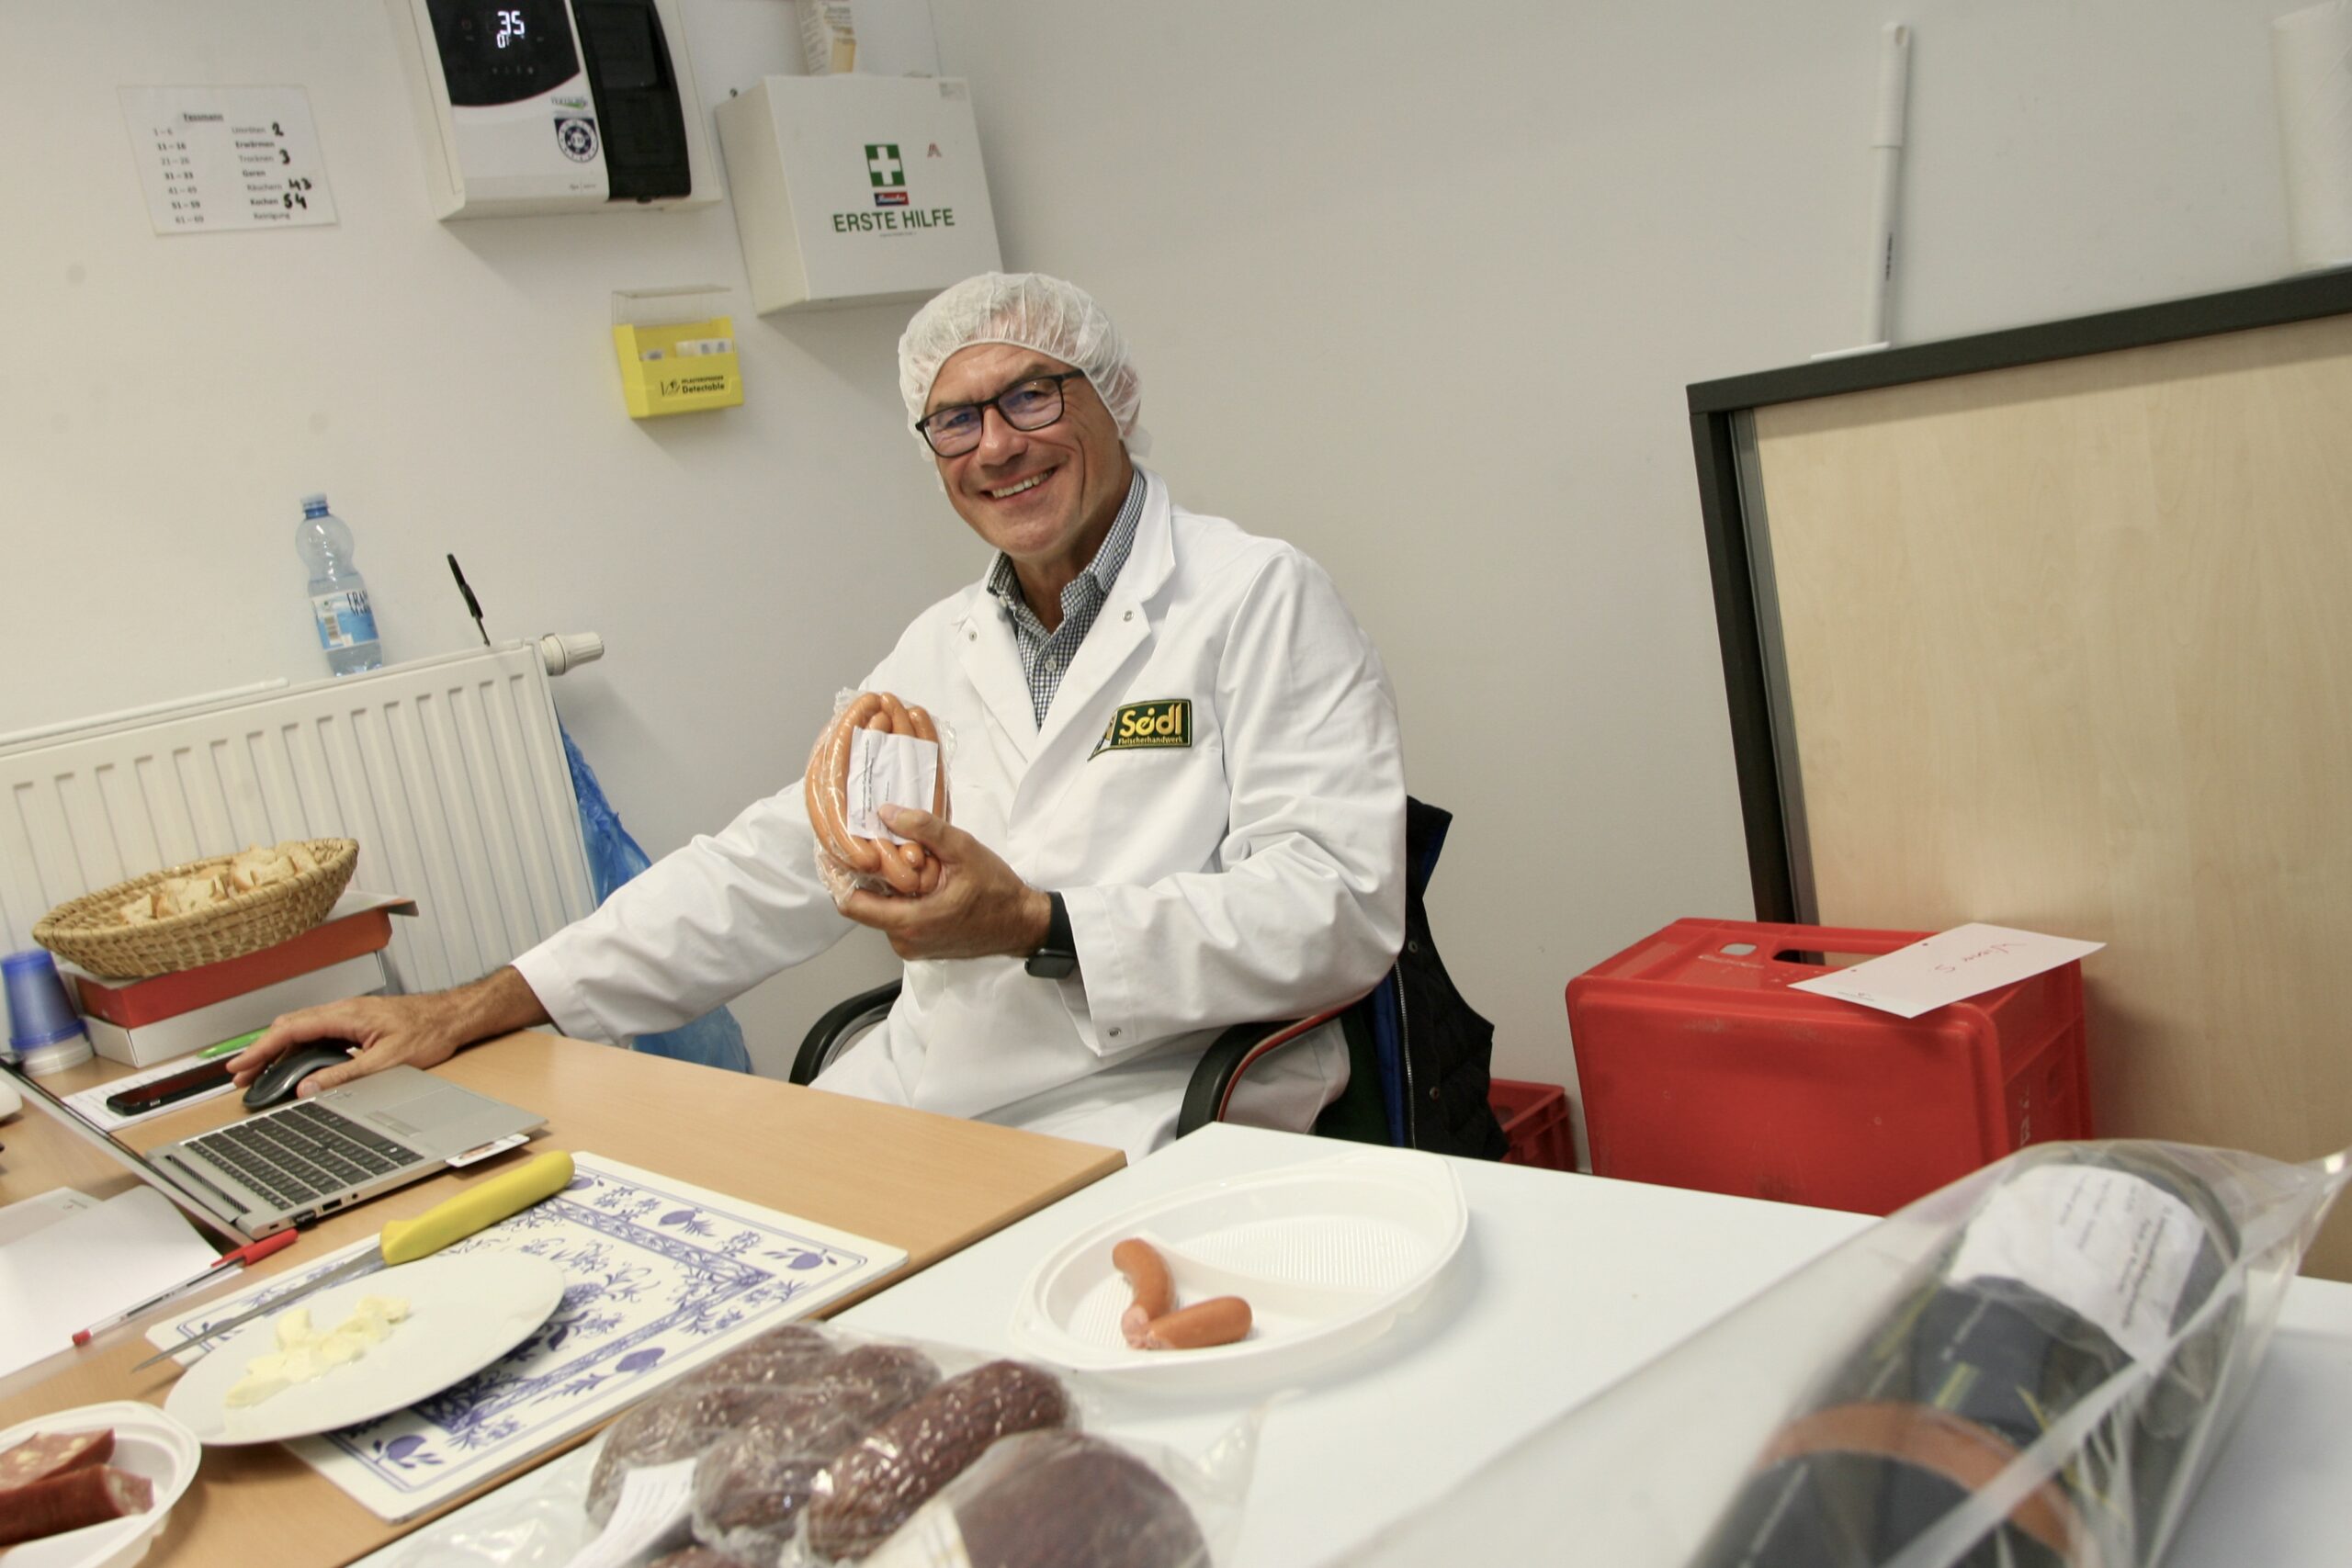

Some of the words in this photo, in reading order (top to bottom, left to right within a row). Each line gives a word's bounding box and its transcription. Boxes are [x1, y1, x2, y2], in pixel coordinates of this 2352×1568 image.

[497, 10, 526, 36] 35
[272, 122, 284, 136] 2
[279, 149, 290, 164] 3
[833, 211, 898, 232] ERSTE
[902, 209, 956, 229] HILFE
[683, 382, 725, 394] Detectable
[1119, 703, 1182, 738] Seidl
[1118, 736, 1183, 745] Fleischerhandwerk
